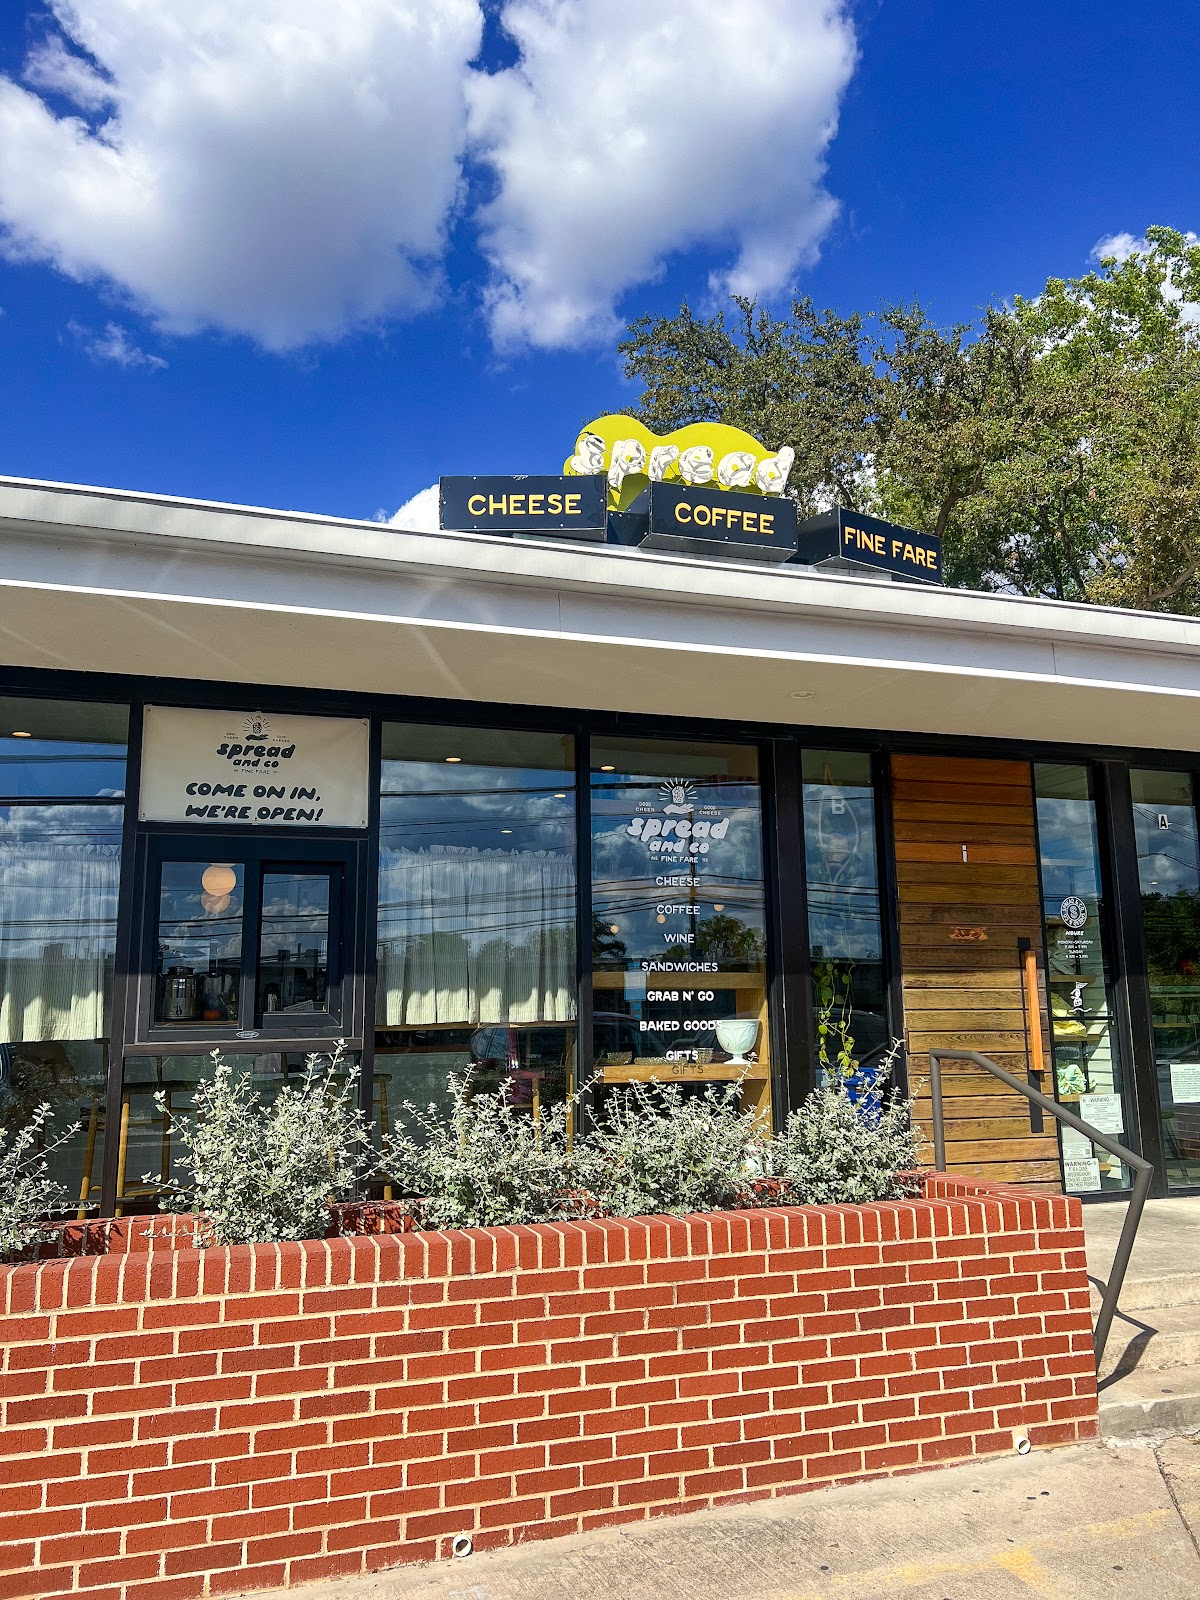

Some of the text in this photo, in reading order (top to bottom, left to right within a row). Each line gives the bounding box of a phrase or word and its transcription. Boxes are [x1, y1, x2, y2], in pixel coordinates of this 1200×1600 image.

[467, 493, 583, 517] CHEESE
[673, 501, 775, 536] COFFEE
[843, 526, 938, 571] FINE FARE
[216, 743, 296, 760] spread
[232, 757, 280, 768] and co
[185, 782, 321, 802] COME ON IN,
[831, 795, 846, 815] B
[185, 804, 324, 822] WE'RE OPEN!
[627, 817, 730, 842] spread
[649, 838, 710, 854] and co
[660, 855, 678, 863] FINE
[679, 856, 699, 864] FARE
[655, 876, 701, 887] CHEESE
[656, 904, 701, 915] COFFEE
[664, 933, 695, 944] WINE
[641, 961, 719, 973] SANDWICHES
[646, 990, 679, 1002] GRAB
[697, 990, 715, 1001] GO
[639, 1020, 723, 1031] BAKED GOODS
[665, 1049, 699, 1061] GIFTS
